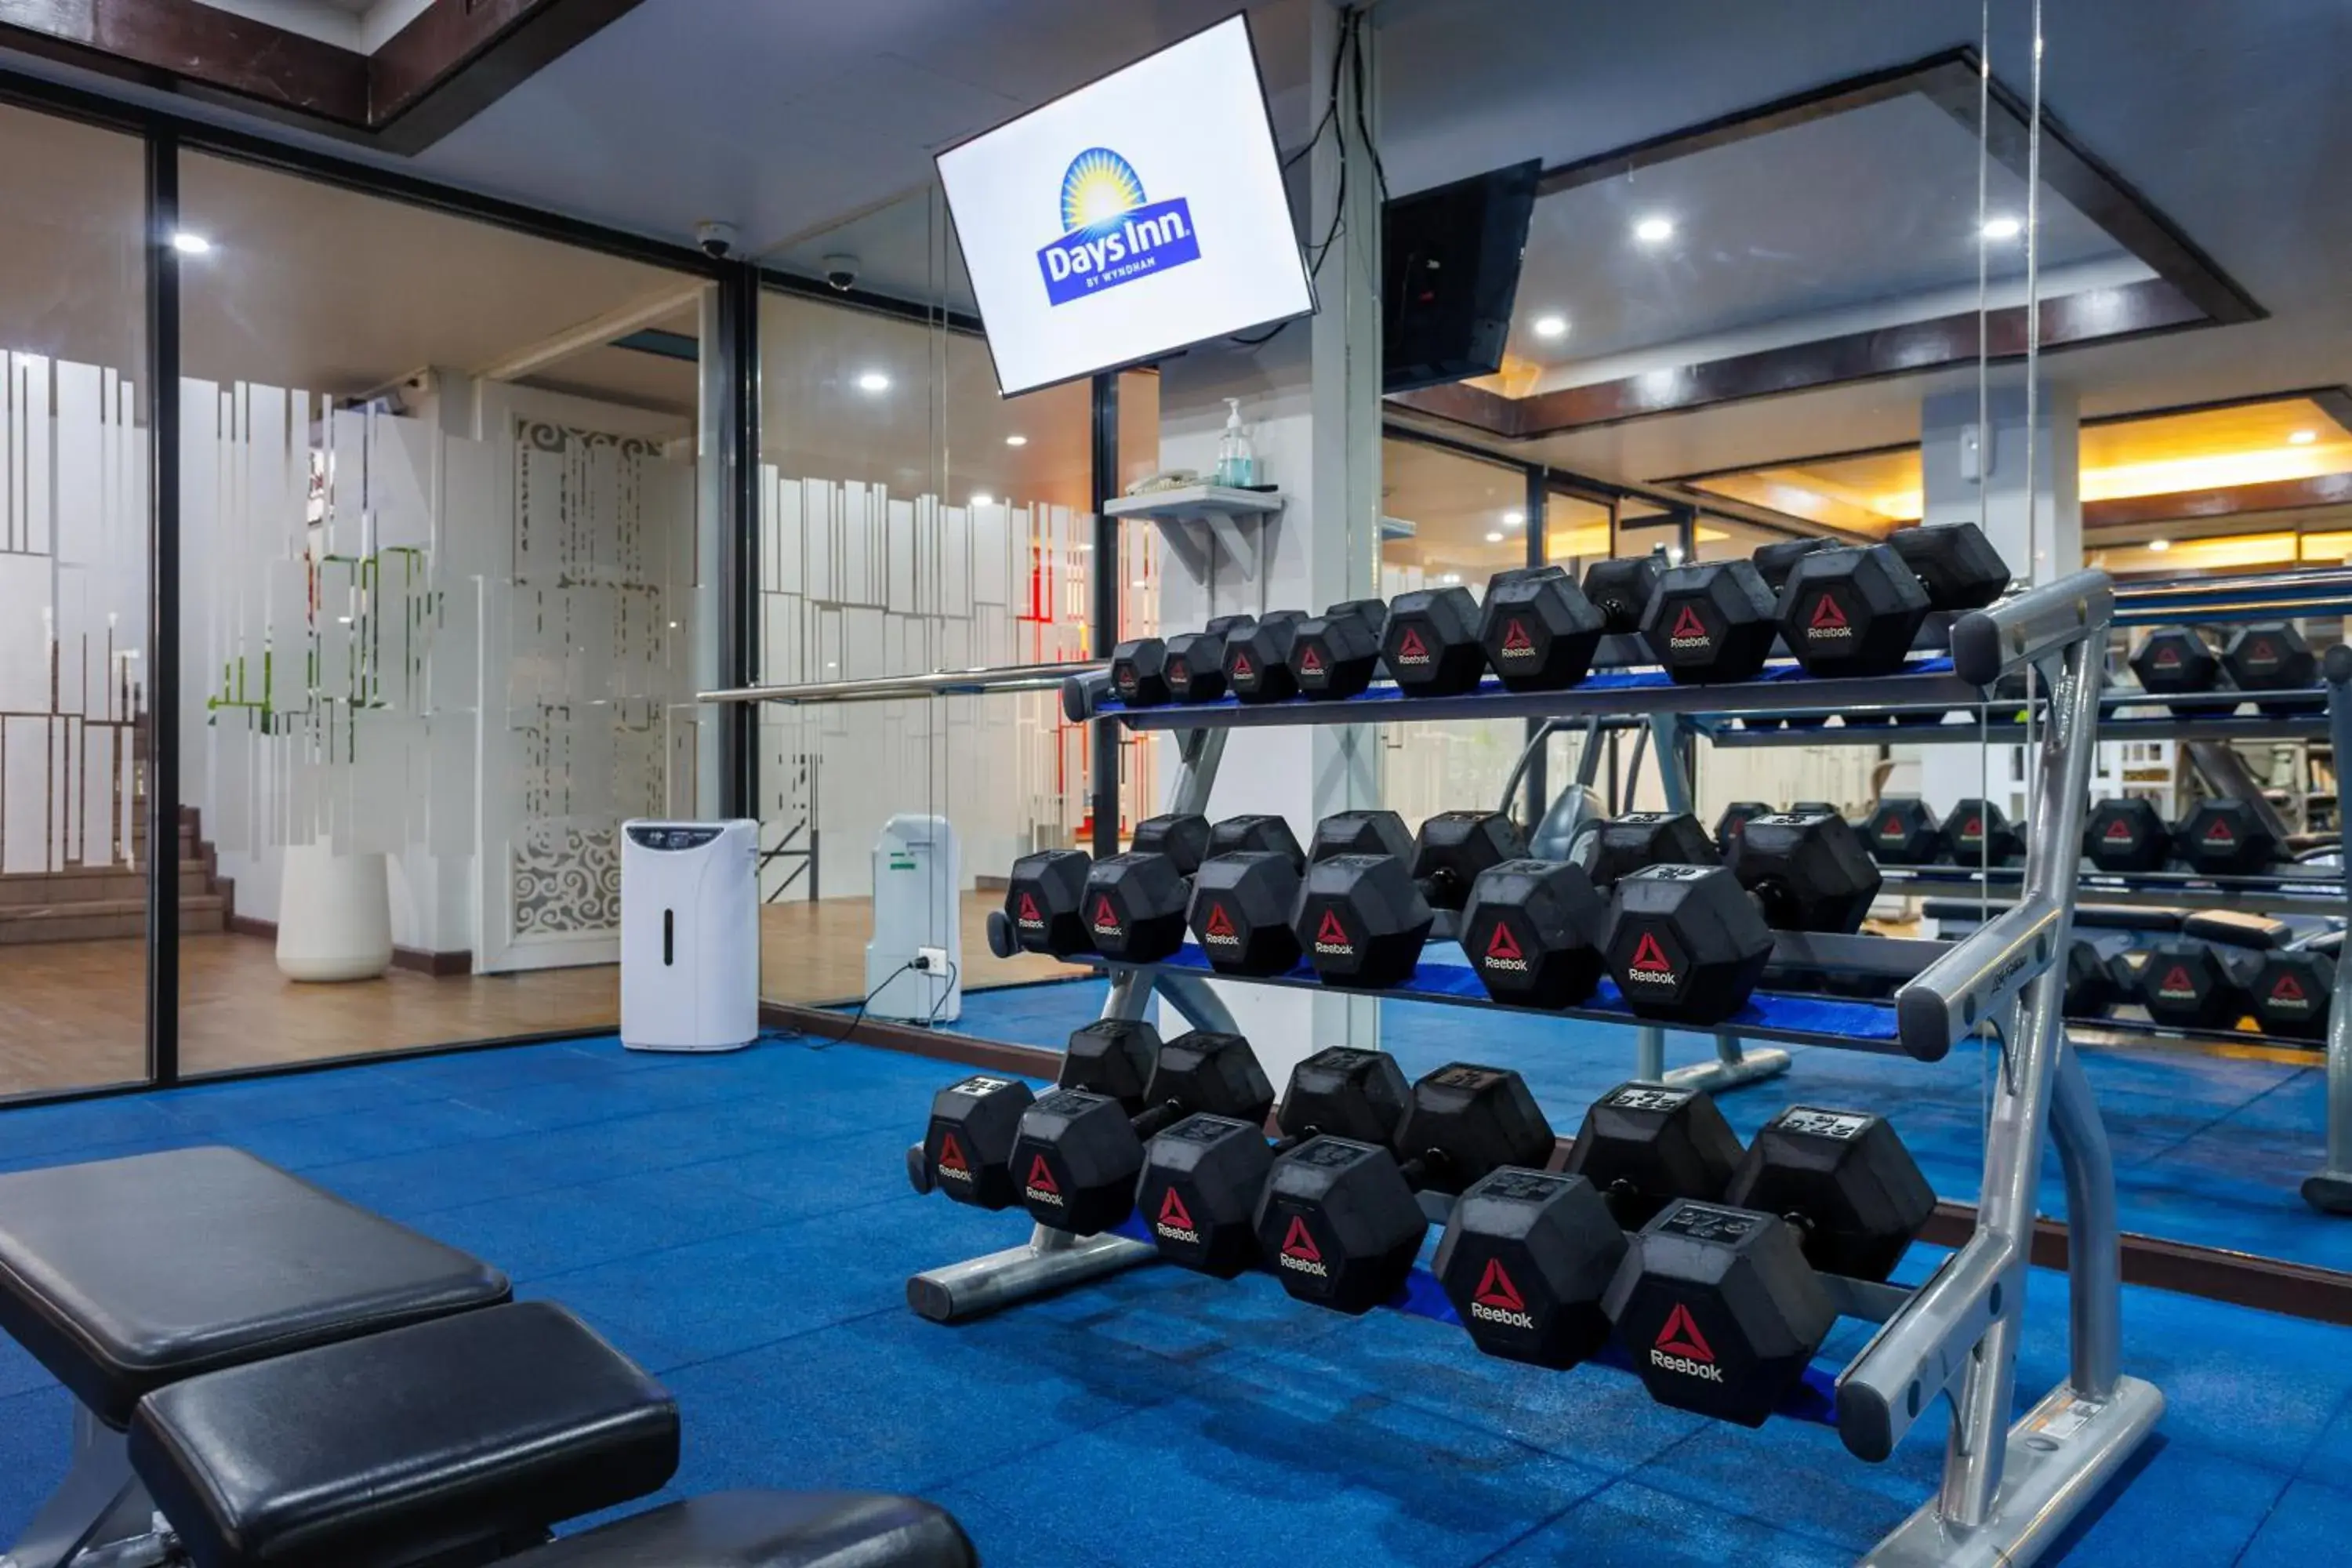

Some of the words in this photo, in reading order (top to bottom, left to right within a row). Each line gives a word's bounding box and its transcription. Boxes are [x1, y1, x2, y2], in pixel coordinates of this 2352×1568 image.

[1045, 231, 1125, 282] Days
[1125, 211, 1186, 256] Inn
[1086, 276, 1099, 289] BY
[1102, 256, 1156, 282] WYNDHAM
[1808, 627, 1853, 639] Reebok
[1671, 634, 1711, 648] Reebok
[1399, 653, 1430, 665] Reebok
[1501, 647, 1536, 659] Reebok
[1018, 917, 1044, 929] Reebok
[1094, 924, 1123, 936] Reebok
[1205, 933, 1240, 946] Reebok
[1316, 942, 1354, 955] Reebok
[1485, 956, 1528, 971] Reebok
[1629, 969, 1675, 985] Reebok
[939, 1164, 972, 1182] Reebok
[1026, 1186, 1064, 1207] Reebok
[1157, 1223, 1200, 1243] Reebok
[1279, 1252, 1327, 1277] Reebok
[1471, 1301, 1534, 1329] Reebok
[1650, 1349, 1723, 1383] Reebok
